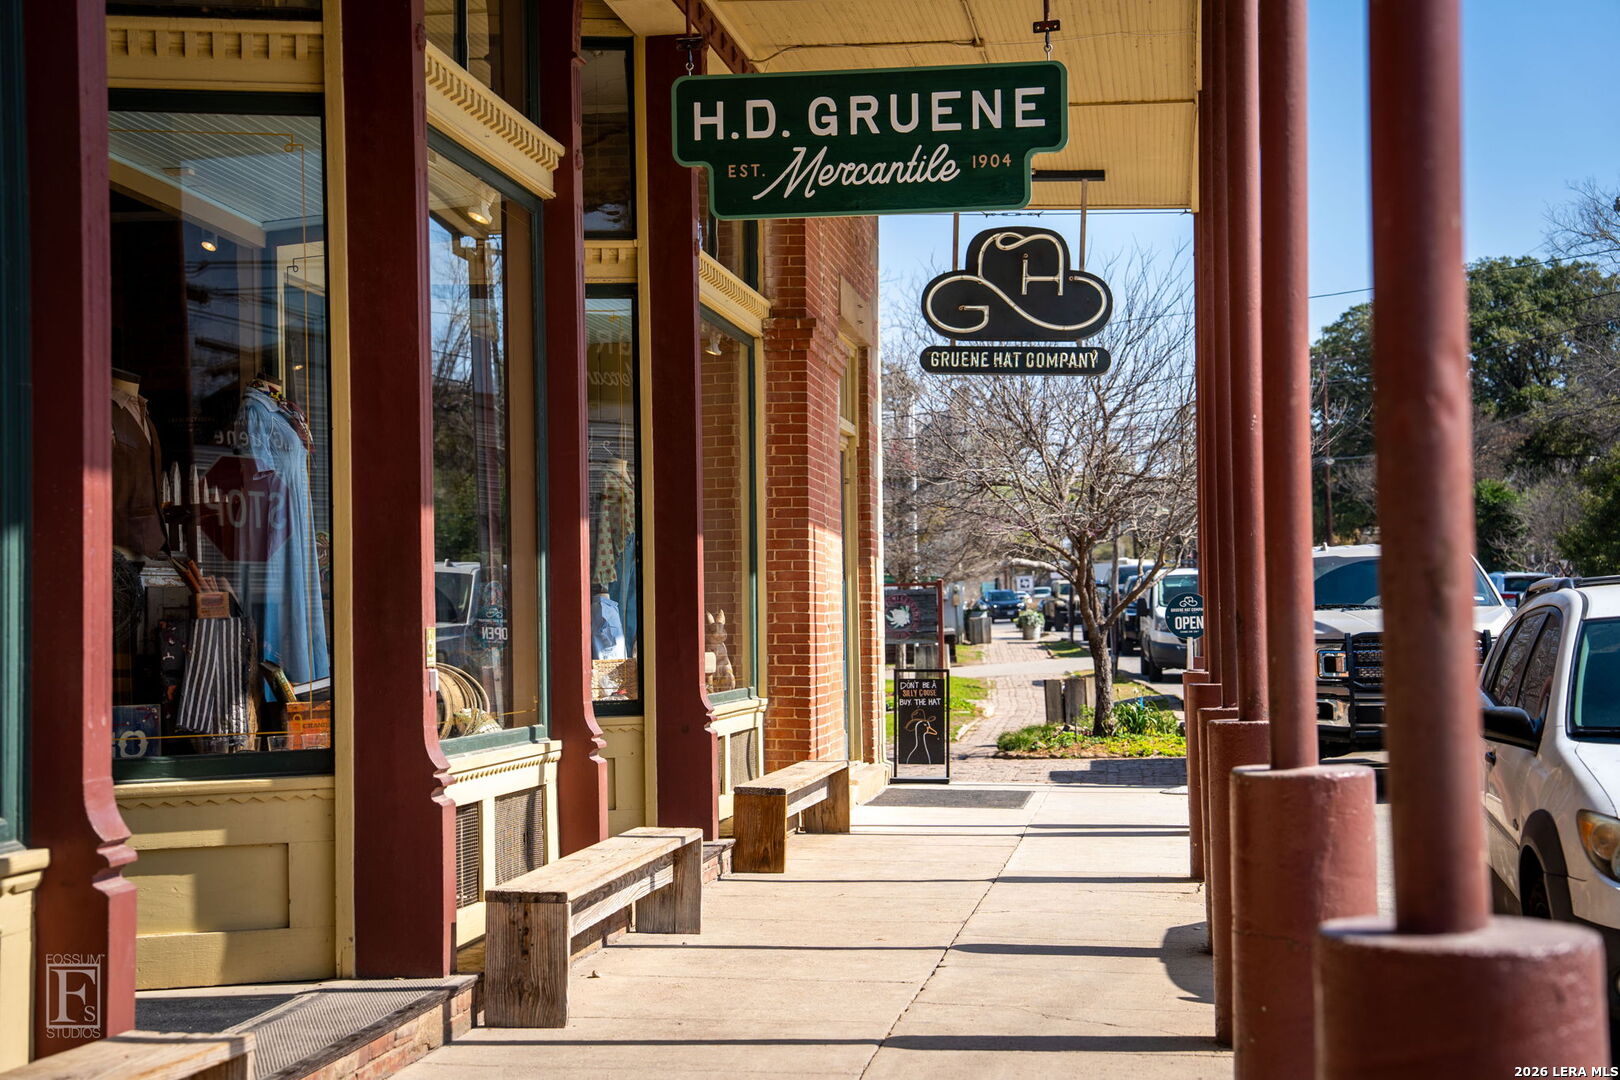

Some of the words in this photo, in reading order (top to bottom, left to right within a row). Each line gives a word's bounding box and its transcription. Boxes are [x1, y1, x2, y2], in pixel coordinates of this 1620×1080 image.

[693, 99, 791, 141] H.D.
[808, 87, 1046, 136] GRUENE
[728, 163, 766, 178] EST.
[752, 143, 961, 200] Mercantile
[972, 153, 1012, 168] 1904
[930, 351, 990, 368] GRUENE
[993, 351, 1022, 368] HAT
[1025, 350, 1099, 369] COMPANY
[1174, 615, 1205, 630] OPEN
[931, 681, 937, 689] A
[899, 698, 911, 706] BUY
[914, 698, 927, 706] THE
[928, 697, 942, 706] HAT
